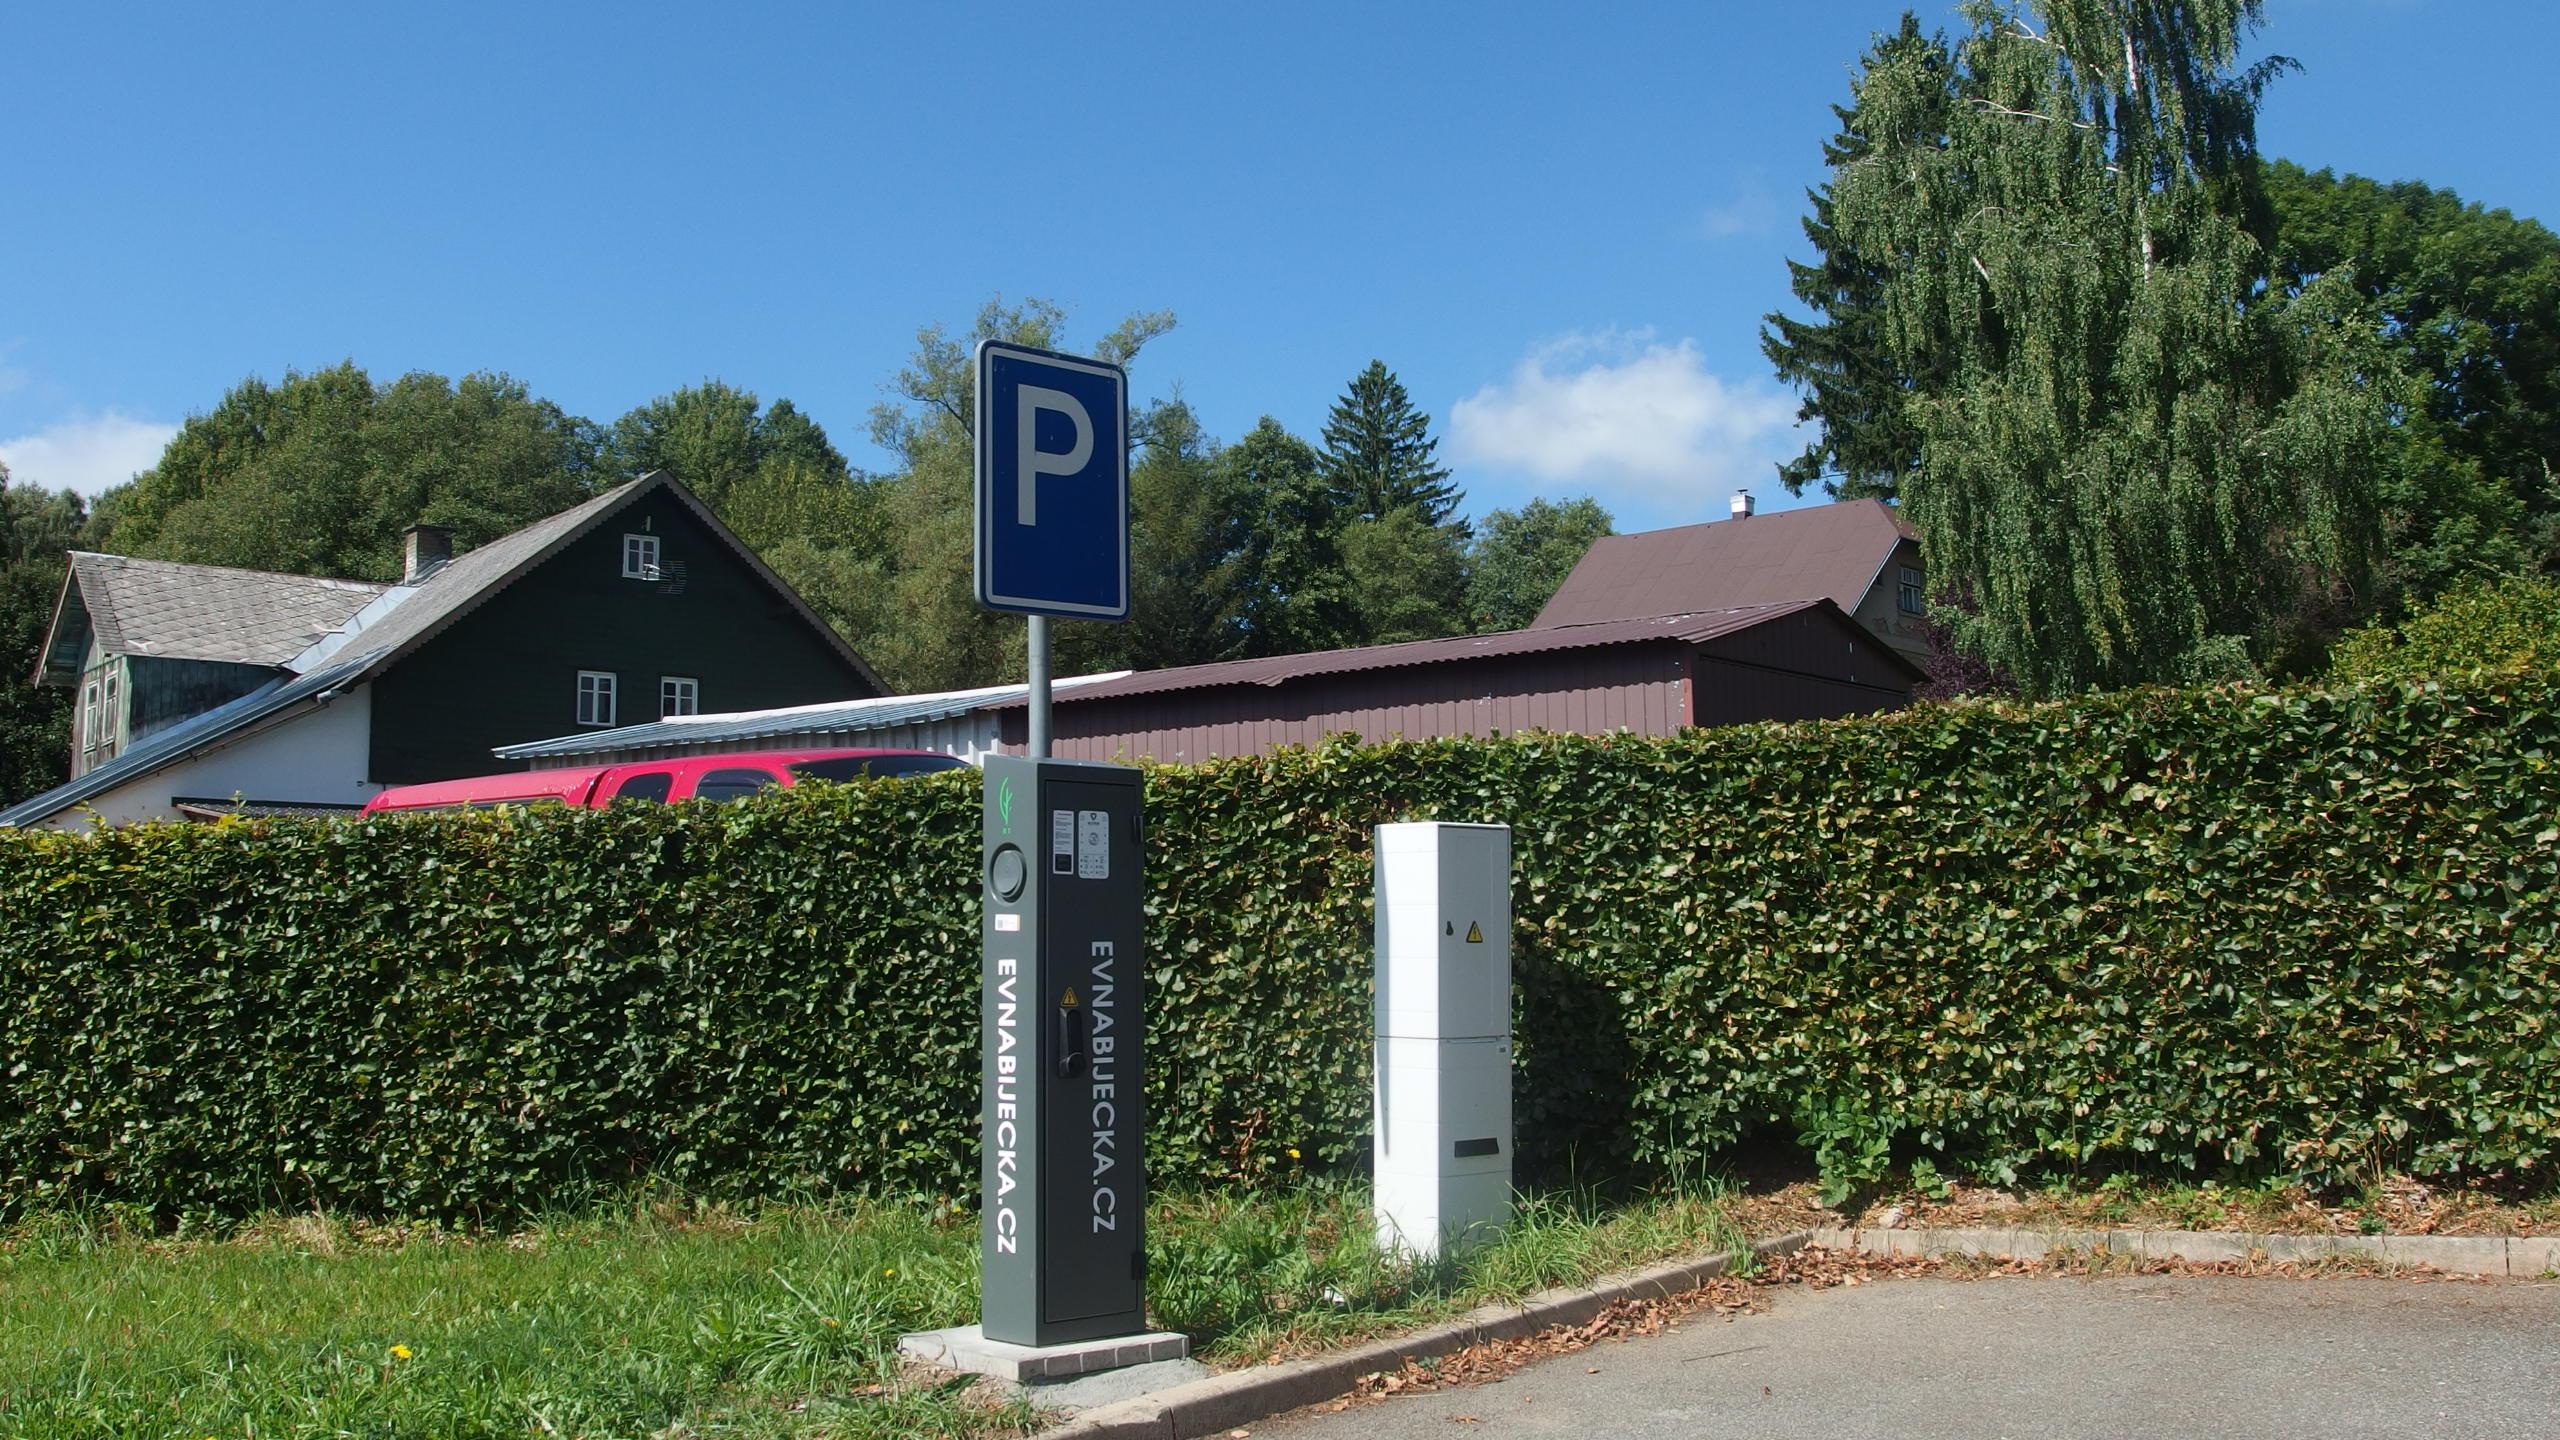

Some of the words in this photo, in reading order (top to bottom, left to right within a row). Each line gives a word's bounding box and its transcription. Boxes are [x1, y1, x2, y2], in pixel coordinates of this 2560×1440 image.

[1017, 384, 1094, 526] P
[997, 958, 1017, 1254] EVNABIJECKA.CZ
[1091, 941, 1116, 1233] EVNABIJECKA.CZ
